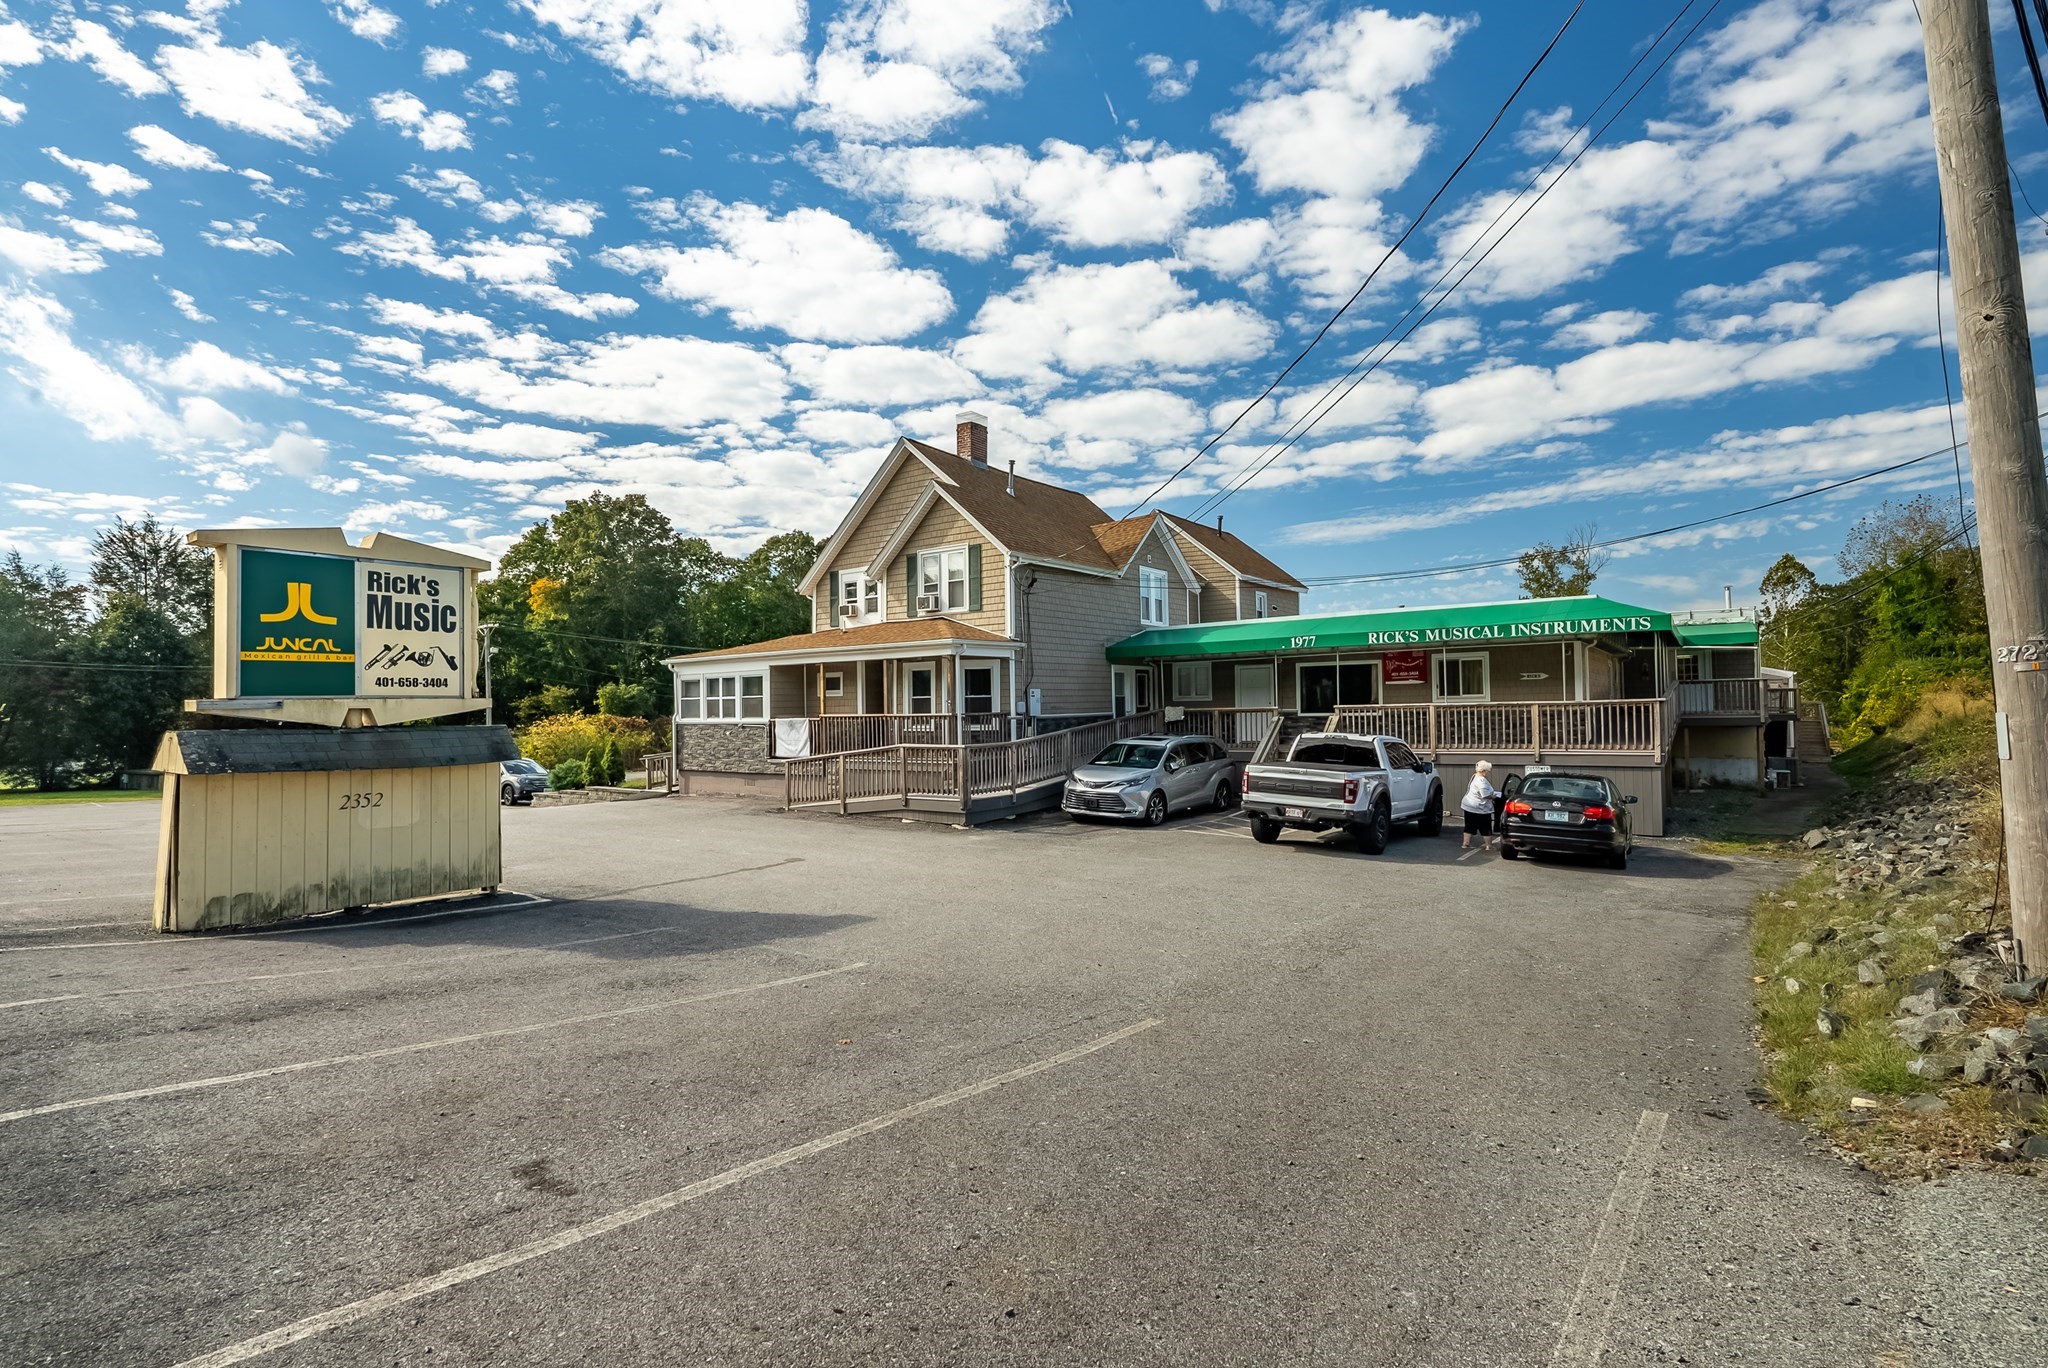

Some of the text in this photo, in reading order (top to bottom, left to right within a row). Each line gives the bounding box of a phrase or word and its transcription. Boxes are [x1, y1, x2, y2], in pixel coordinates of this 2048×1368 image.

[368, 570, 440, 597] Rick's
[366, 593, 457, 634] Music
[1368, 617, 1651, 644] RICK'S MUSICAL INSTRUMENTS
[256, 637, 341, 652] JUNCAL
[1290, 635, 1316, 648] 1977
[244, 652, 291, 660] Mexican
[296, 653, 320, 661] grill
[375, 677, 448, 688] 401-658-3404
[338, 792, 384, 811] 2352
